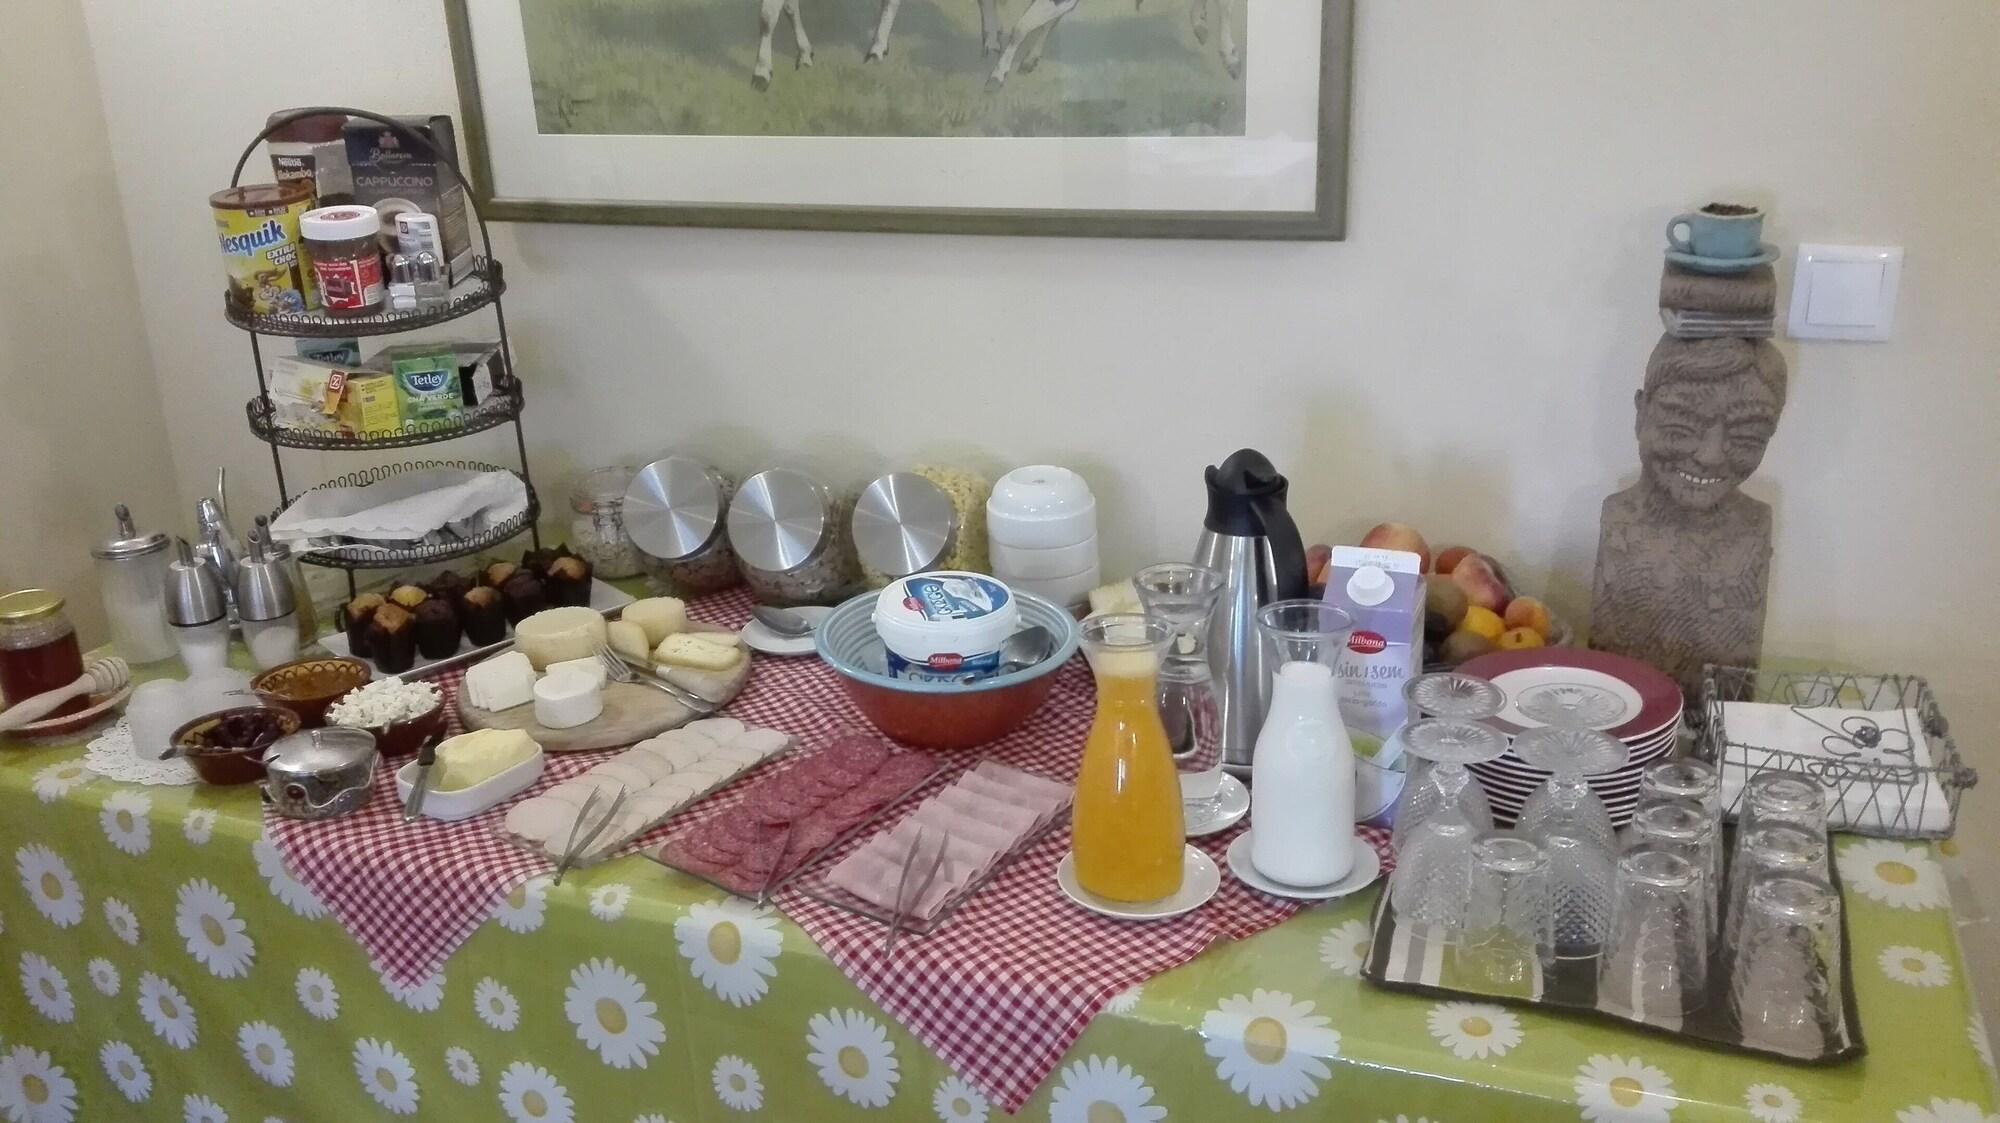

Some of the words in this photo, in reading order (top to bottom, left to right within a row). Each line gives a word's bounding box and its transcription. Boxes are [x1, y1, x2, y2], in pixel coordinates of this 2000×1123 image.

[356, 176, 433, 187] CAPPUCCINO
[218, 220, 287, 256] Nesquik
[266, 243, 295, 258] EXTRA
[274, 252, 296, 265] CHOC
[410, 373, 444, 387] Tetley
[1337, 661, 1362, 678] sin
[1370, 665, 1405, 679] sem
